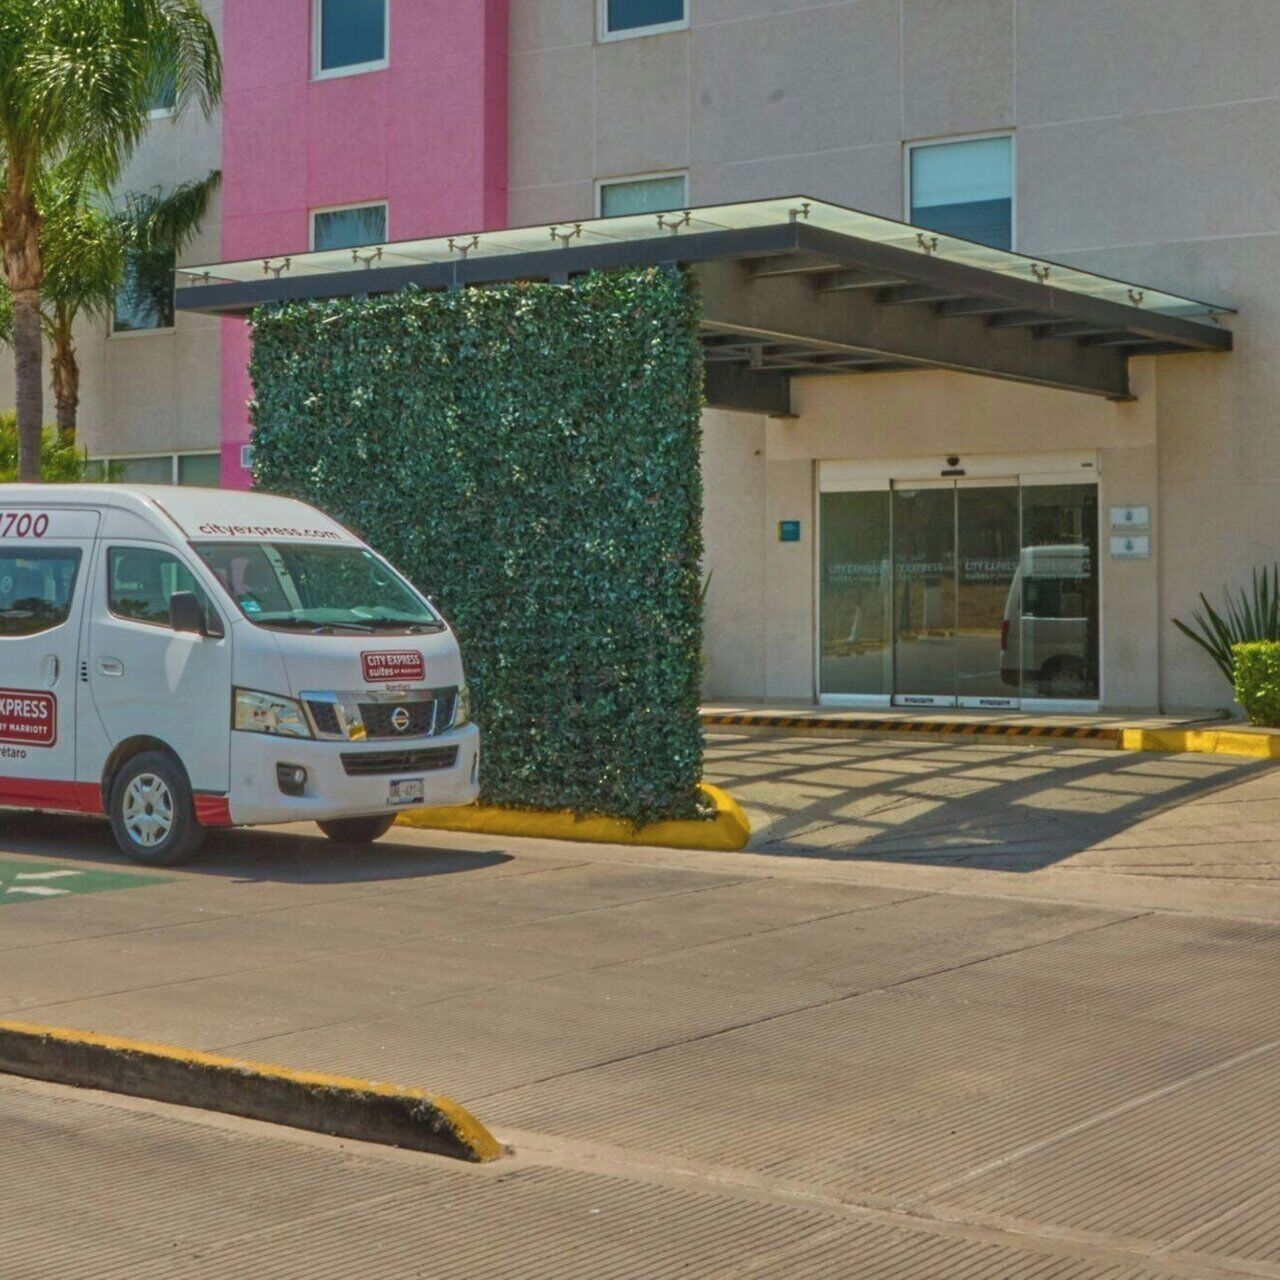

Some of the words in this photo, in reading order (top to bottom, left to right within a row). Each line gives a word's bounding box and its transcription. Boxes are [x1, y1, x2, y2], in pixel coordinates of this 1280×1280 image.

[198, 522, 342, 540] cityexpress.com
[367, 655, 385, 666] CITY
[387, 654, 420, 666] EXPRESS
[369, 667, 394, 677] suites
[9, 723, 47, 734] MARRIOTT
